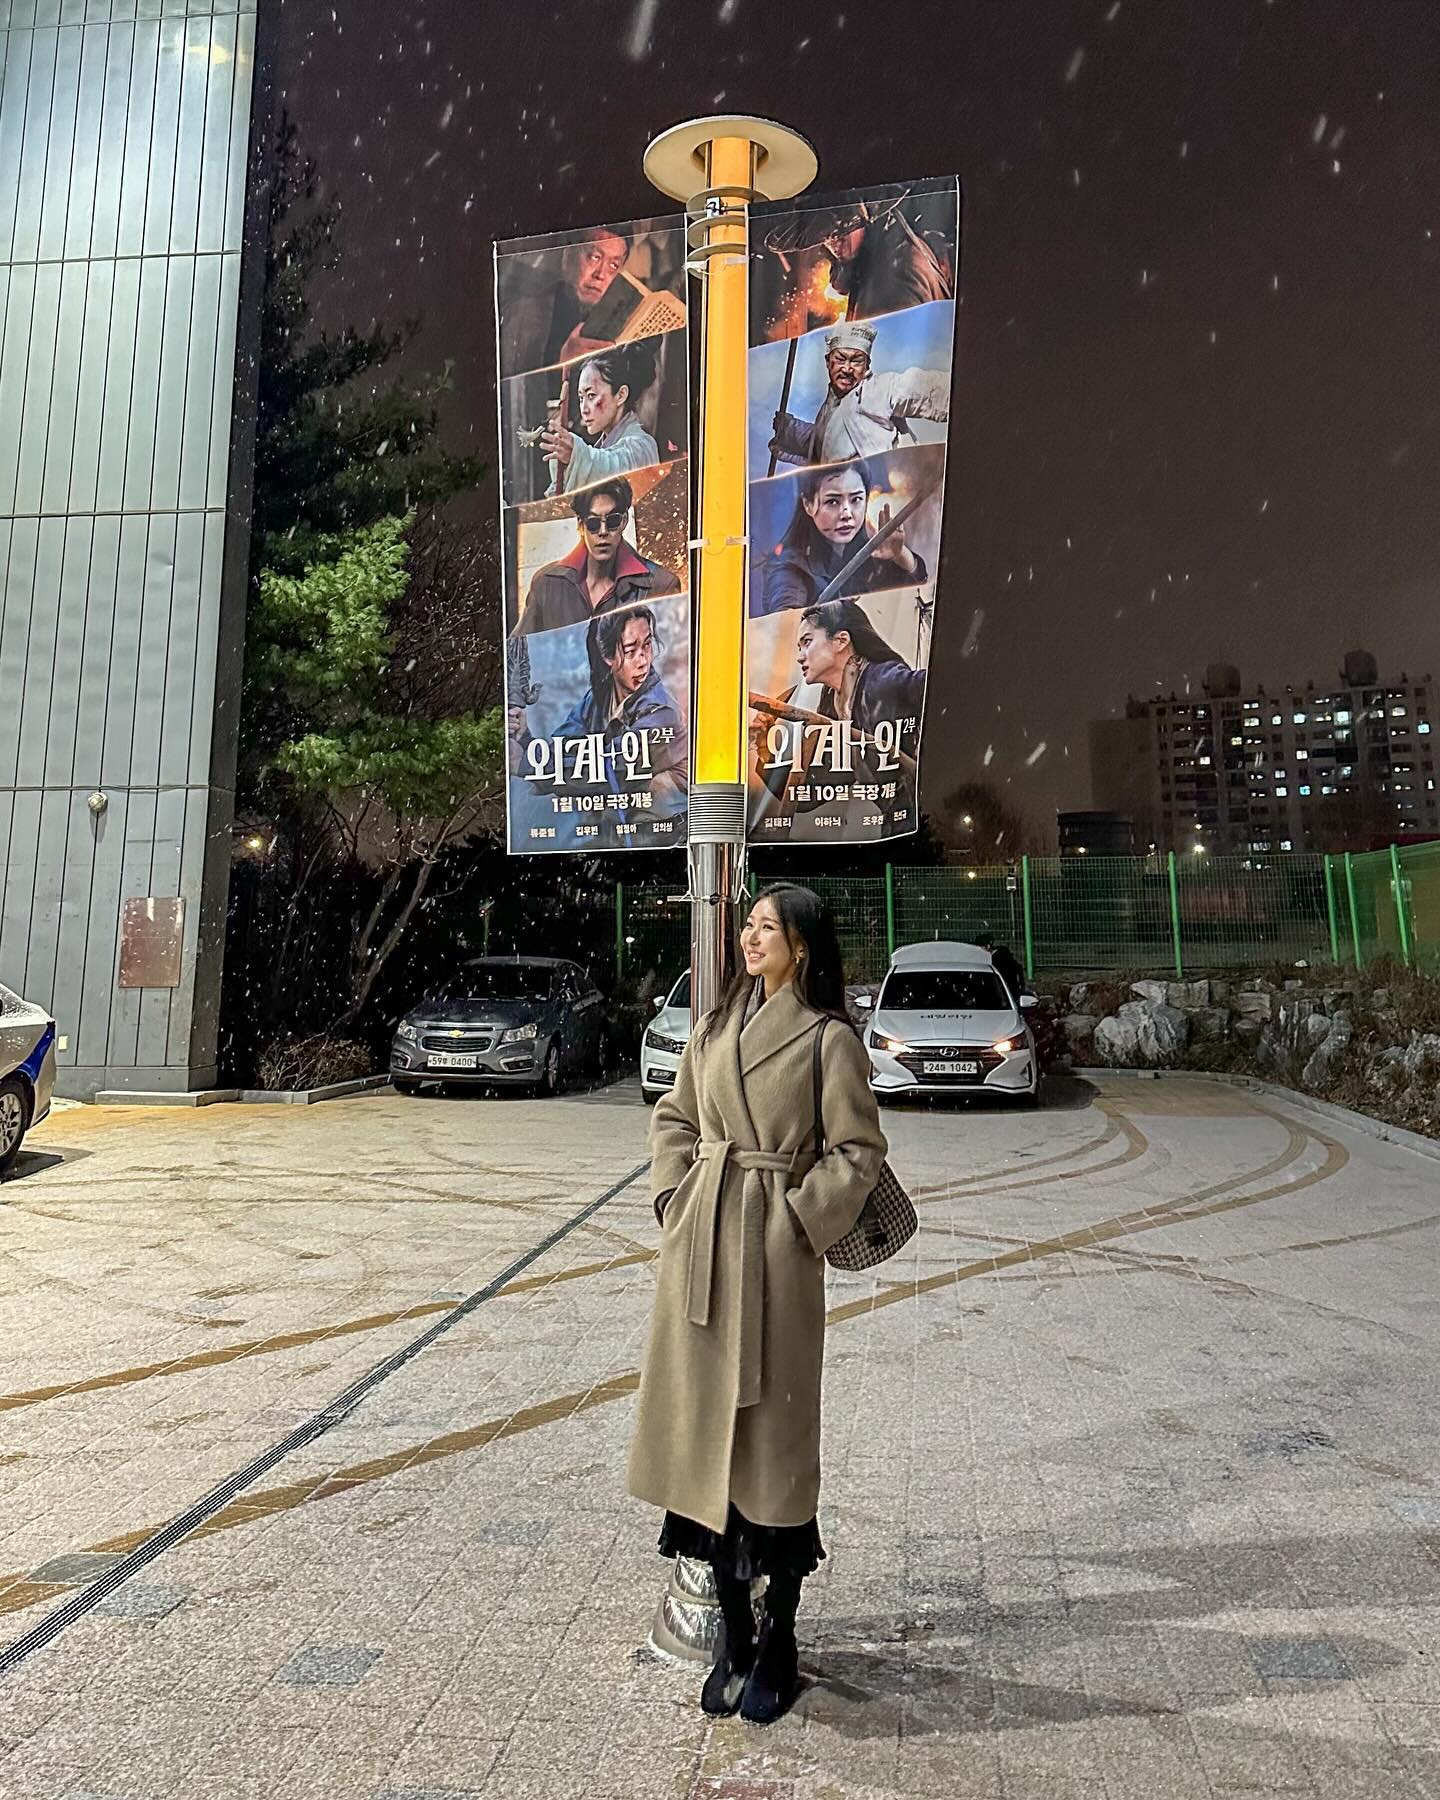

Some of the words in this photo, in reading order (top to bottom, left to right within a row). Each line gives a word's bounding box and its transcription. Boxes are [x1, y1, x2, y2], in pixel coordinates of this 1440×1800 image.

[763, 719, 903, 773] 외계+인
[524, 729, 653, 786] 외계+인
[651, 727, 675, 745] 2부
[787, 785, 811, 801] 1월
[815, 784, 849, 801] 10일
[852, 784, 879, 801] 극장
[551, 796, 573, 813] 1월
[576, 794, 605, 812] 10일
[606, 793, 629, 810] 극장
[630, 792, 653, 809] 개봉
[814, 816, 841, 827] 이하늬
[451, 1057, 473, 1067] 0400
[950, 1063, 973, 1072] 1042
